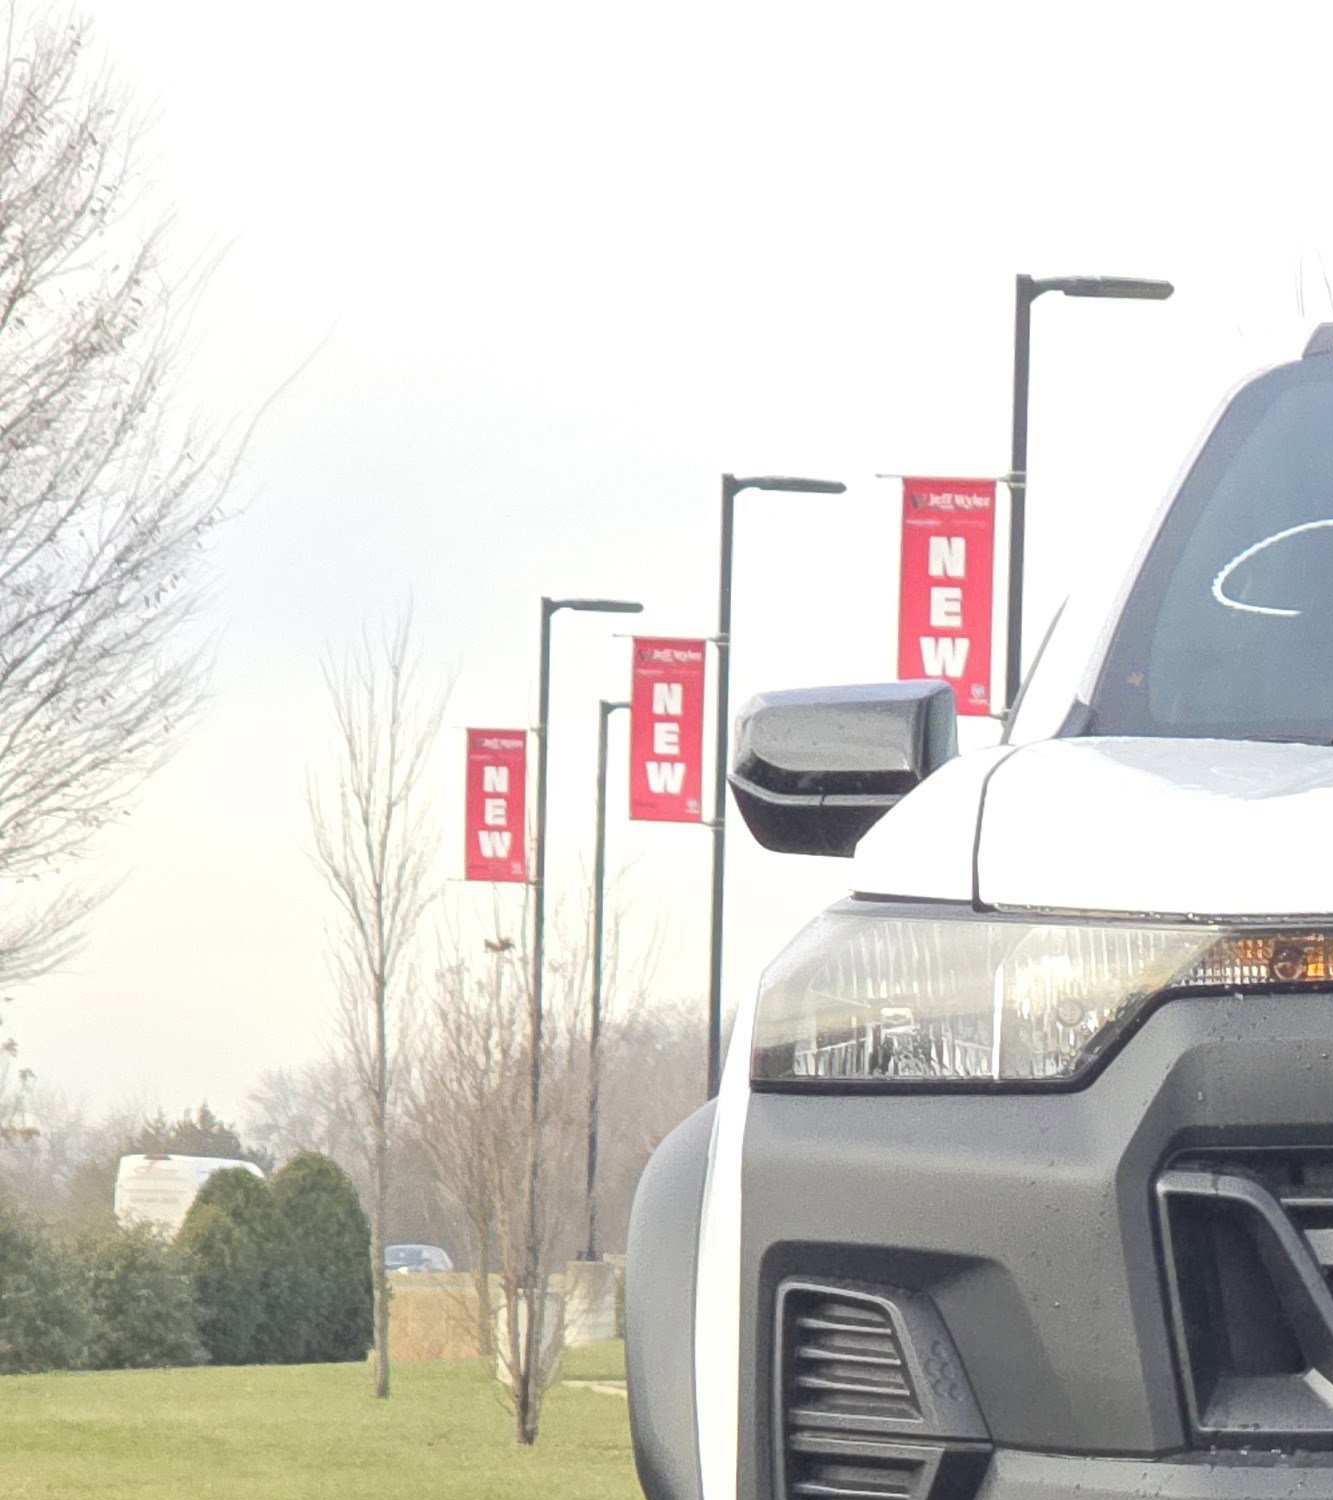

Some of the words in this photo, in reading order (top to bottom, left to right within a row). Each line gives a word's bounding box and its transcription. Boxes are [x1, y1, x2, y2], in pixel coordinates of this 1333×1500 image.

[918, 535, 970, 679] NEW
[645, 682, 687, 794] NEW
[477, 765, 513, 860] NEW
